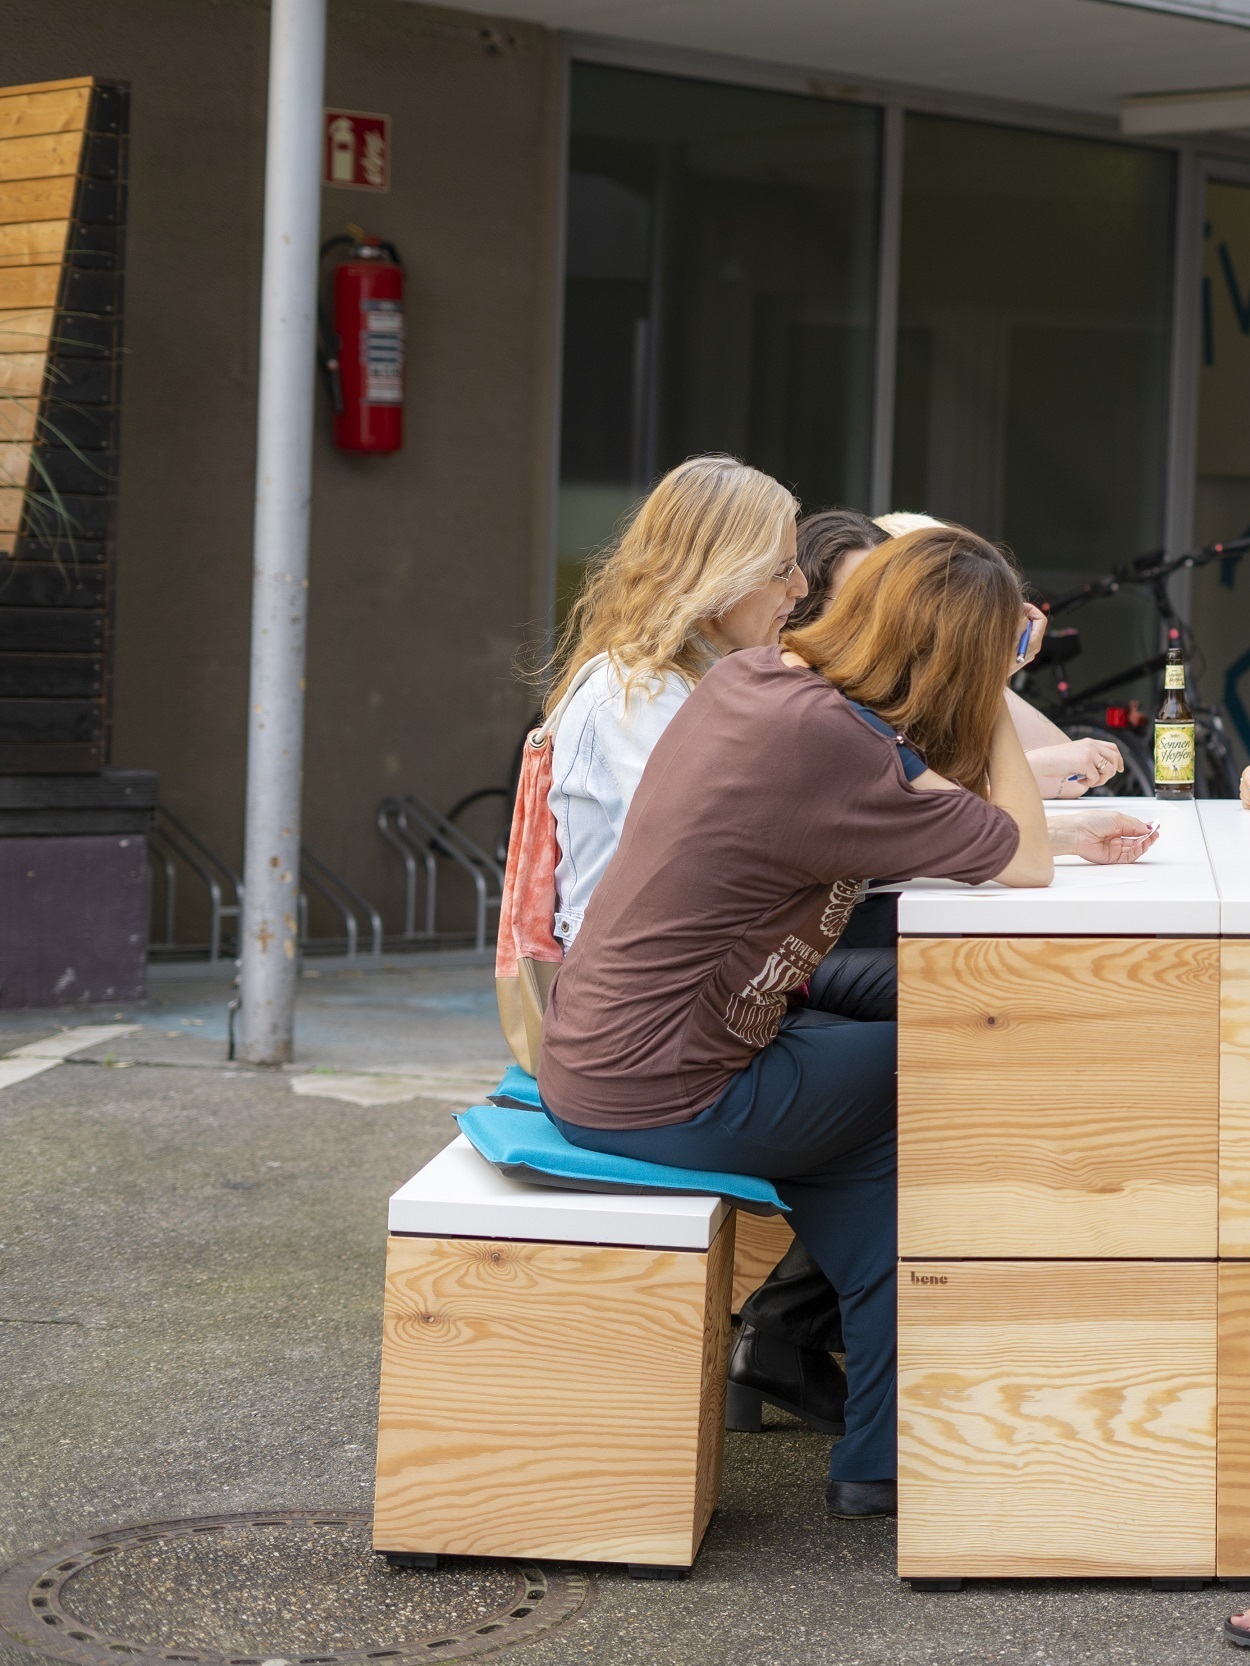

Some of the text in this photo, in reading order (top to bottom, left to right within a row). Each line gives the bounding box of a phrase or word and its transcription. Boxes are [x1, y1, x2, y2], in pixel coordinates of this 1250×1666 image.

[1158, 737, 1191, 750] Sonnen
[1161, 749, 1192, 763] Hopfen
[781, 934, 814, 960] PUNK
[910, 1271, 949, 1285] bene
